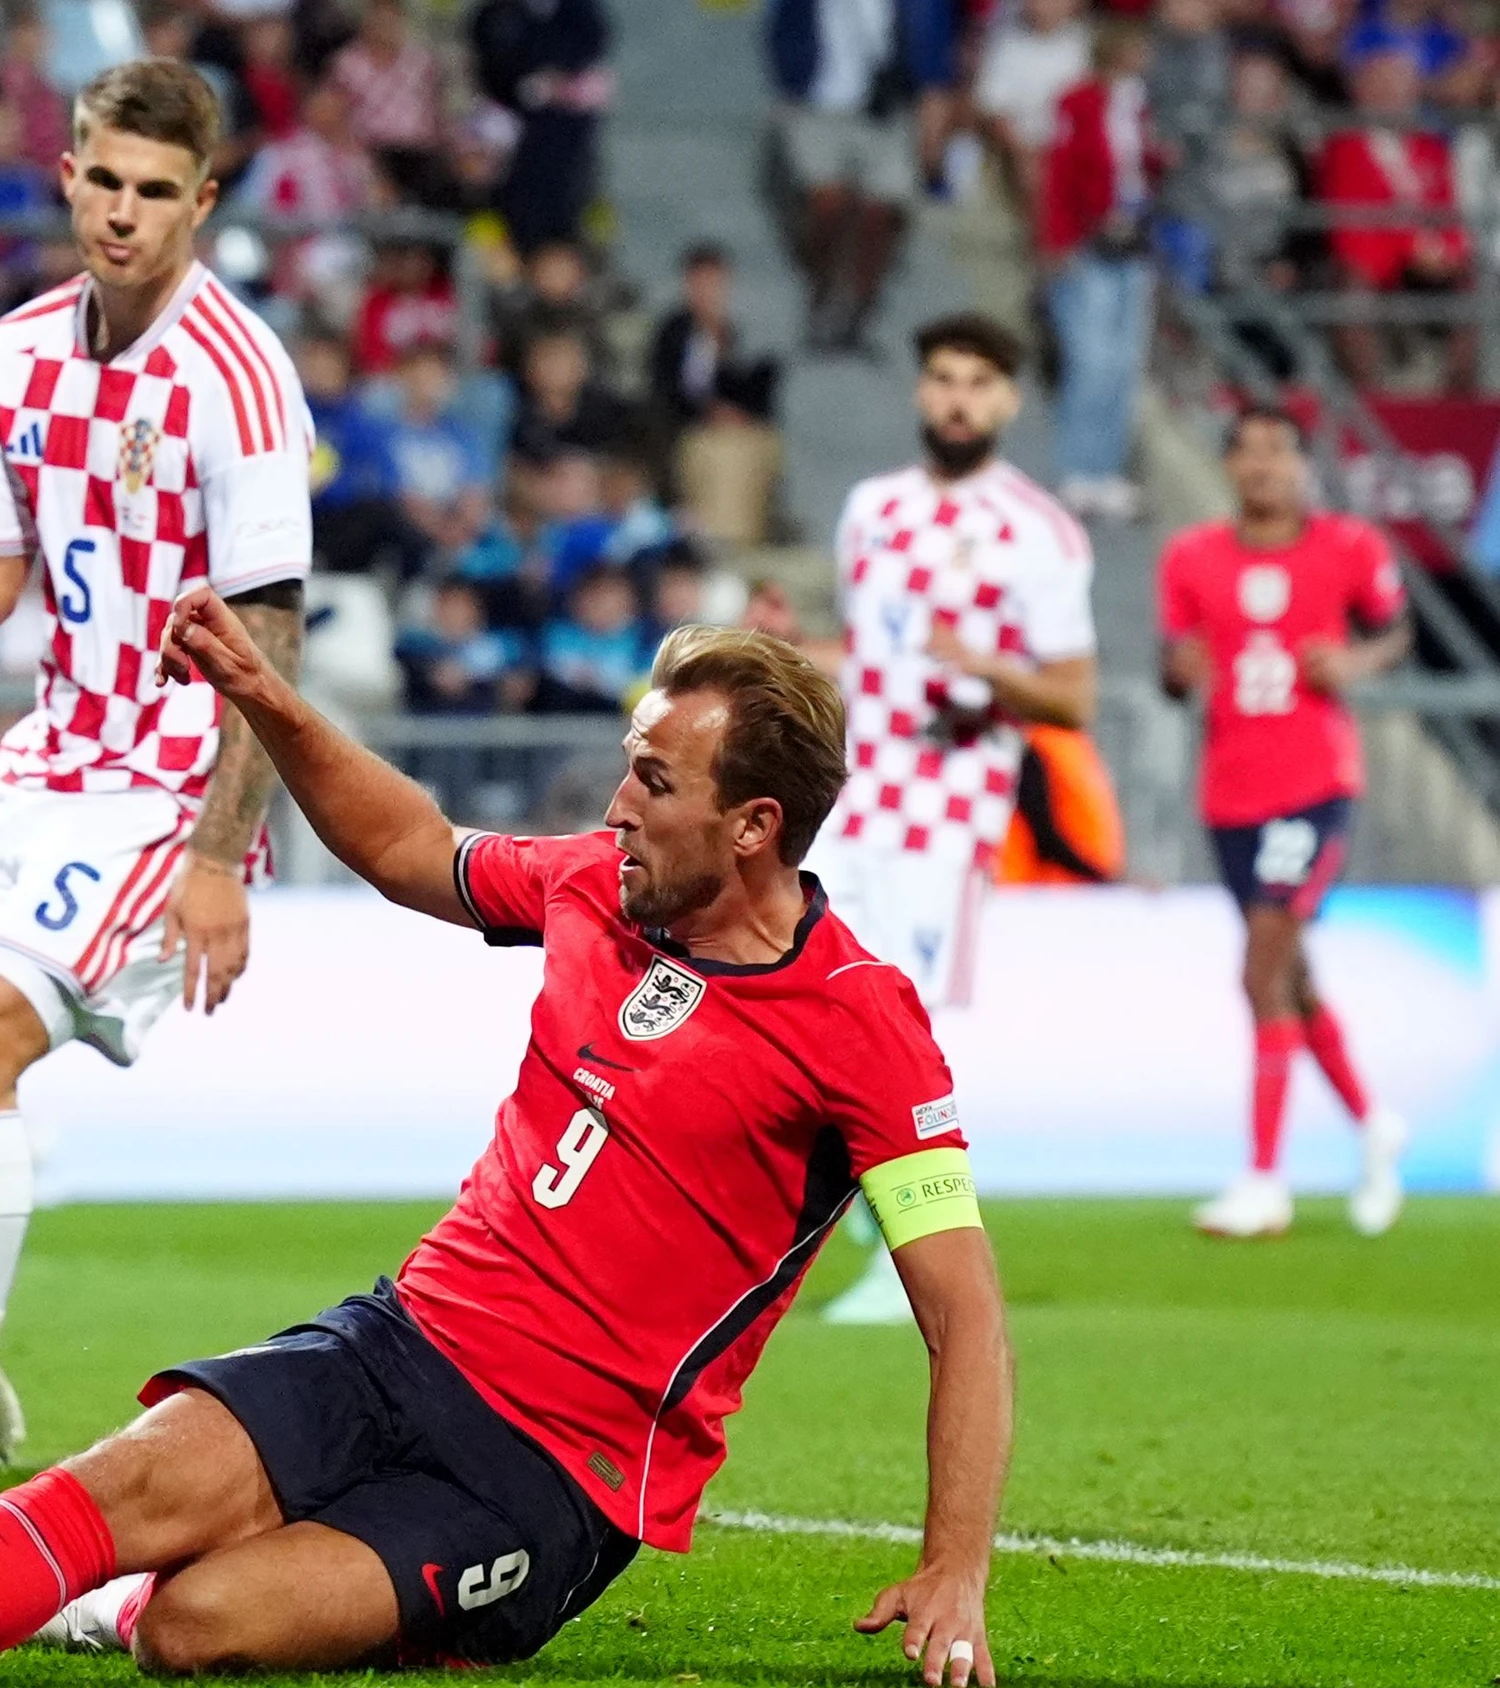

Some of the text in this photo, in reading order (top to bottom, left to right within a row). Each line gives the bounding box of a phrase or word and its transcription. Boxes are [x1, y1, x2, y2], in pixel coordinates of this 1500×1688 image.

[62, 539, 97, 624] 5
[34, 860, 102, 932] 5
[573, 1066, 616, 1101] CROATIA
[531, 1106, 611, 1211] 9
[921, 1177, 977, 1199] RESPEC
[457, 1547, 531, 1612] 9
